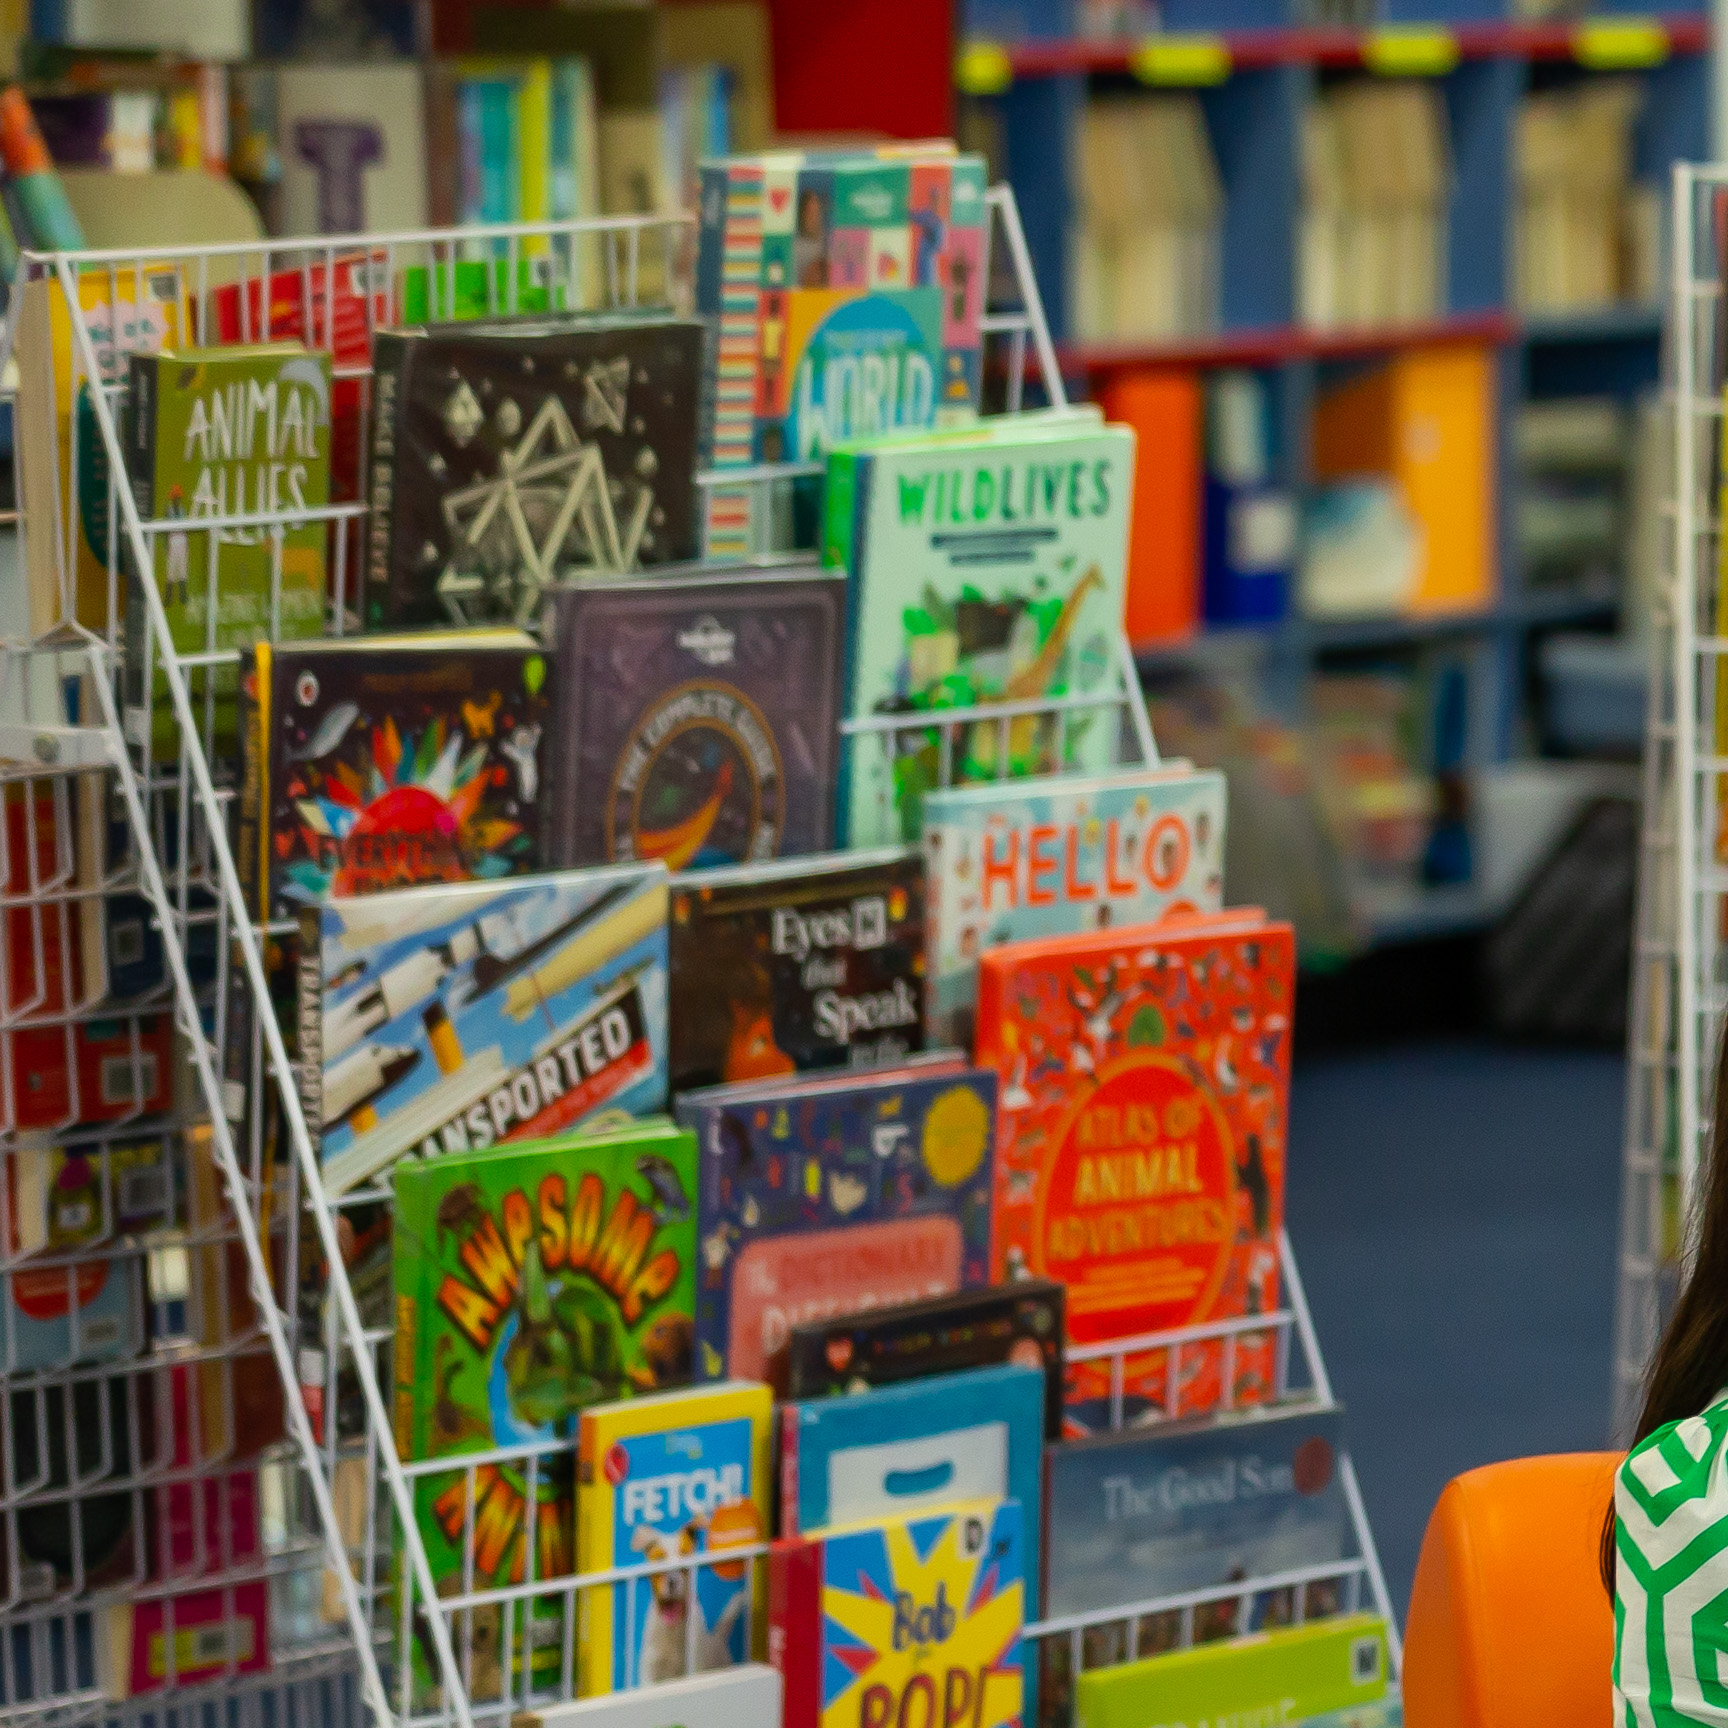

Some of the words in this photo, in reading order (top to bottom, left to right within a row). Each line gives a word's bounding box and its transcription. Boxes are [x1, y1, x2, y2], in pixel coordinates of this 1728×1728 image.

[184, 375, 321, 463] ANIMAL
[896, 458, 1113, 526] WILDLIVES
[979, 814, 1192, 914] HELLO
[366, 1005, 632, 1190] TANSPORTED
[1073, 1140, 1204, 1204] ANIMAL
[622, 1462, 744, 1527] FETCH!
[892, 1580, 956, 1654] Bob
